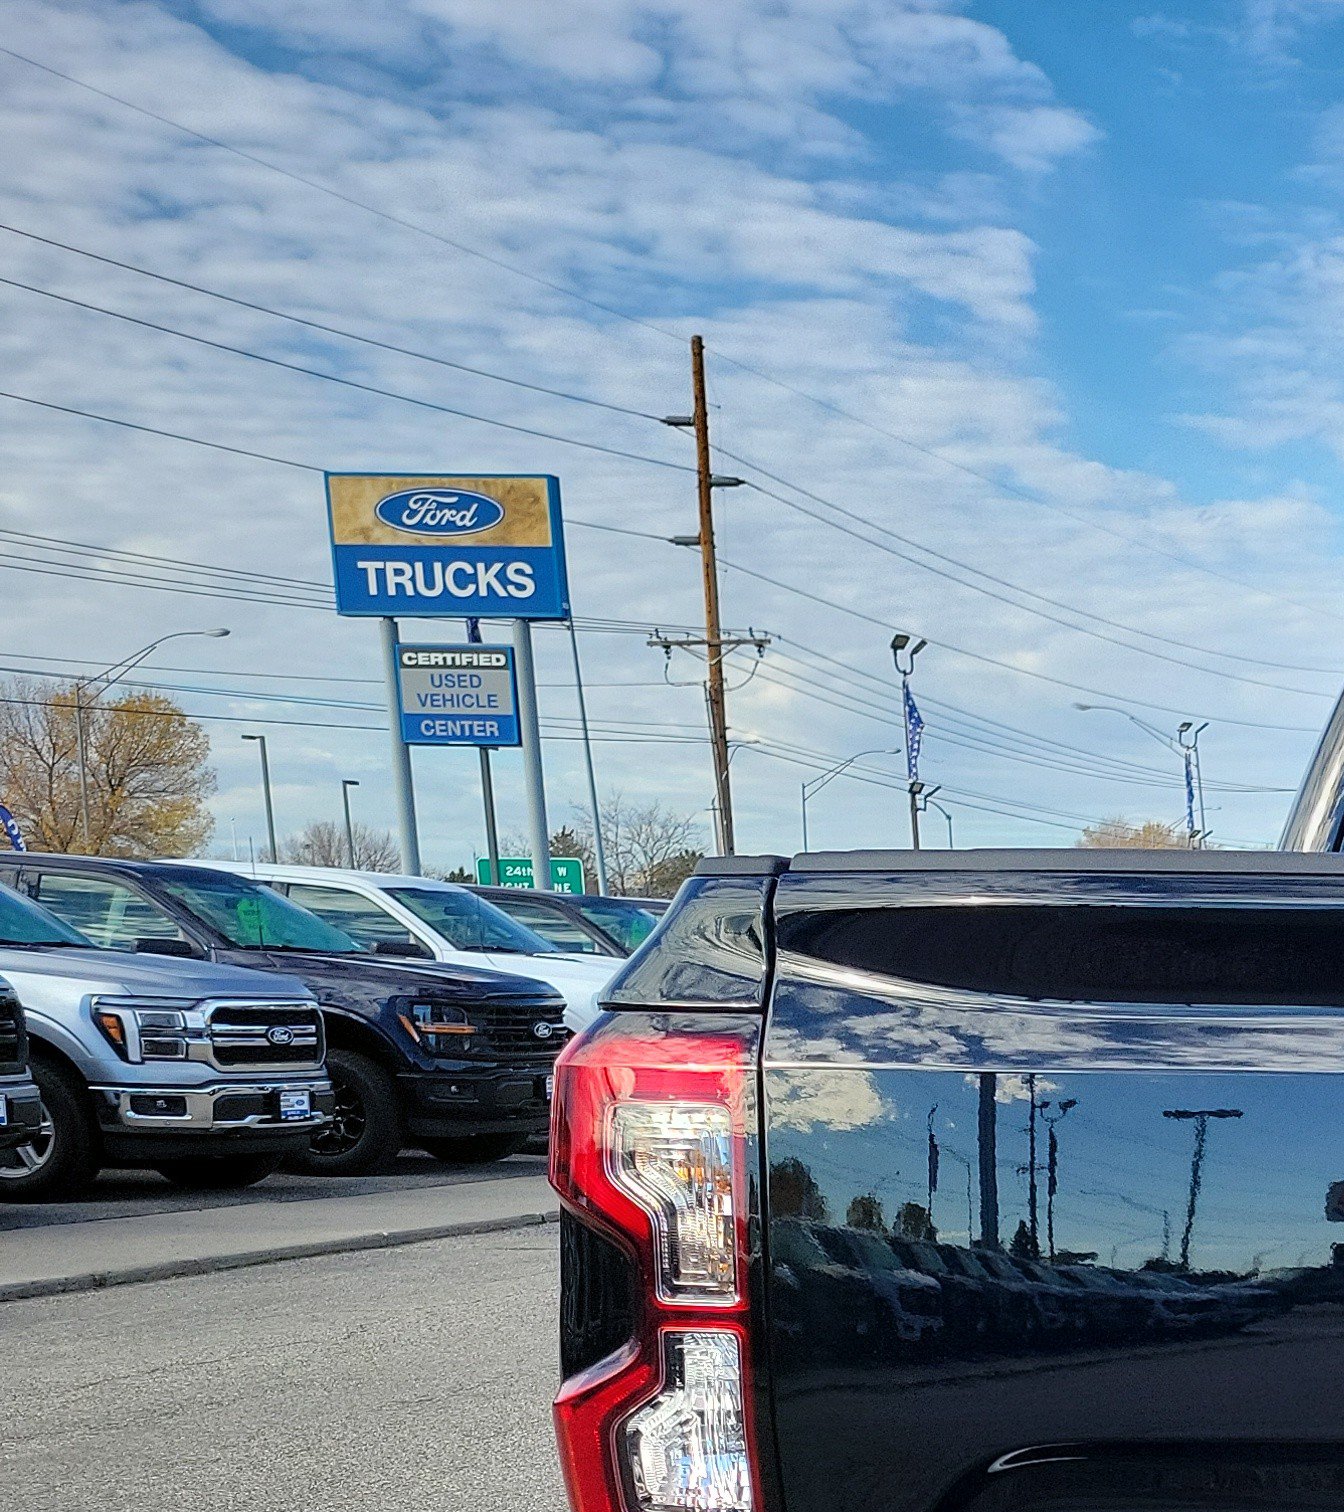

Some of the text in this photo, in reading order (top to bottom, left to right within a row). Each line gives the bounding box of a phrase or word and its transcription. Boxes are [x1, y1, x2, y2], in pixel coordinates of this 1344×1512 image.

[401, 493, 478, 528] Ford
[357, 561, 536, 598] TRUCKS
[401, 652, 507, 667] CERTIFIED
[430, 673, 482, 689] USED
[417, 693, 499, 709] VEHICLE
[420, 719, 500, 737] CENTER
[505, 866, 567, 877] 24th W
